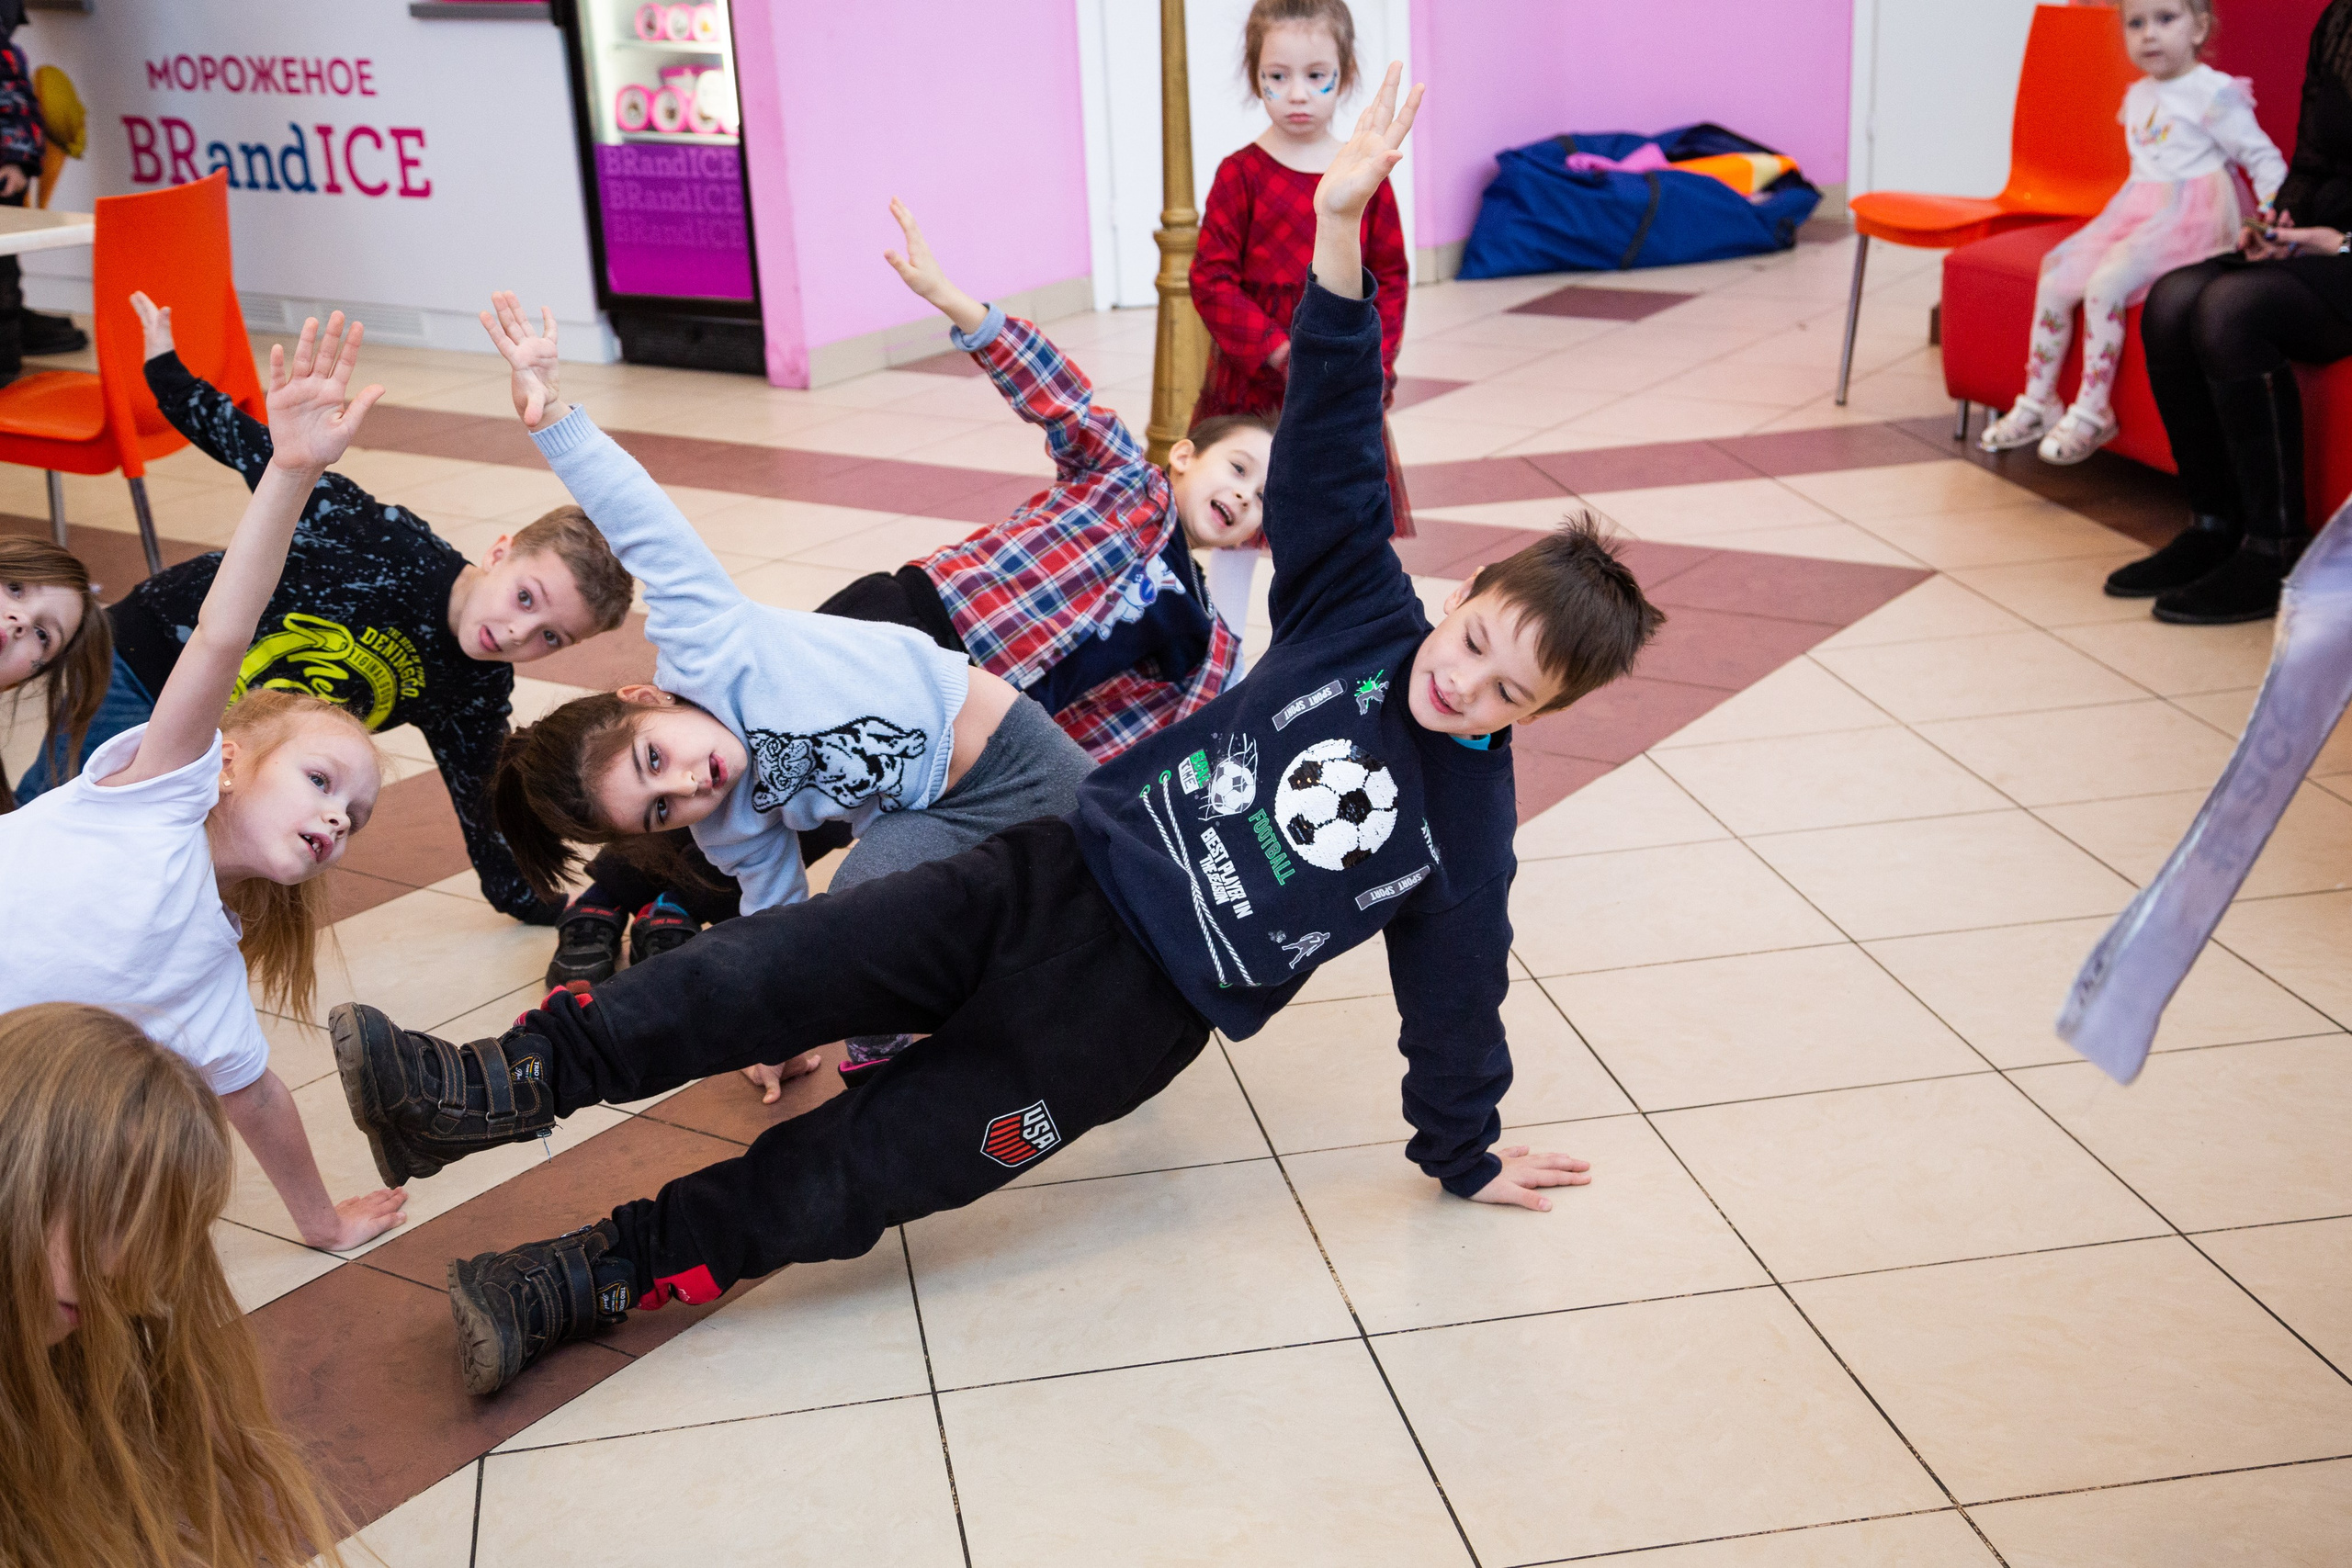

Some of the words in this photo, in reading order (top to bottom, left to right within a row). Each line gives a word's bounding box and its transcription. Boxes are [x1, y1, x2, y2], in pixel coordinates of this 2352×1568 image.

[145, 53, 379, 96] МОРОЖЕНОЕ
[120, 114, 433, 199] BRandICE
[1283, 700, 1306, 721] SPORT
[1307, 686, 1333, 707] SPORT
[1180, 759, 1197, 790] TIME
[1248, 807, 1296, 886] FOOTBALL
[1198, 853, 1218, 874] THE
[1200, 827, 1229, 863] BEST
[1217, 860, 1247, 902] PLAYER
[1232, 899, 1254, 919] IN
[1206, 873, 1230, 906] SEASON
[1369, 886, 1396, 901] SPORT
[1397, 873, 1422, 891] SPORT
[1022, 1106, 1056, 1149] USA
